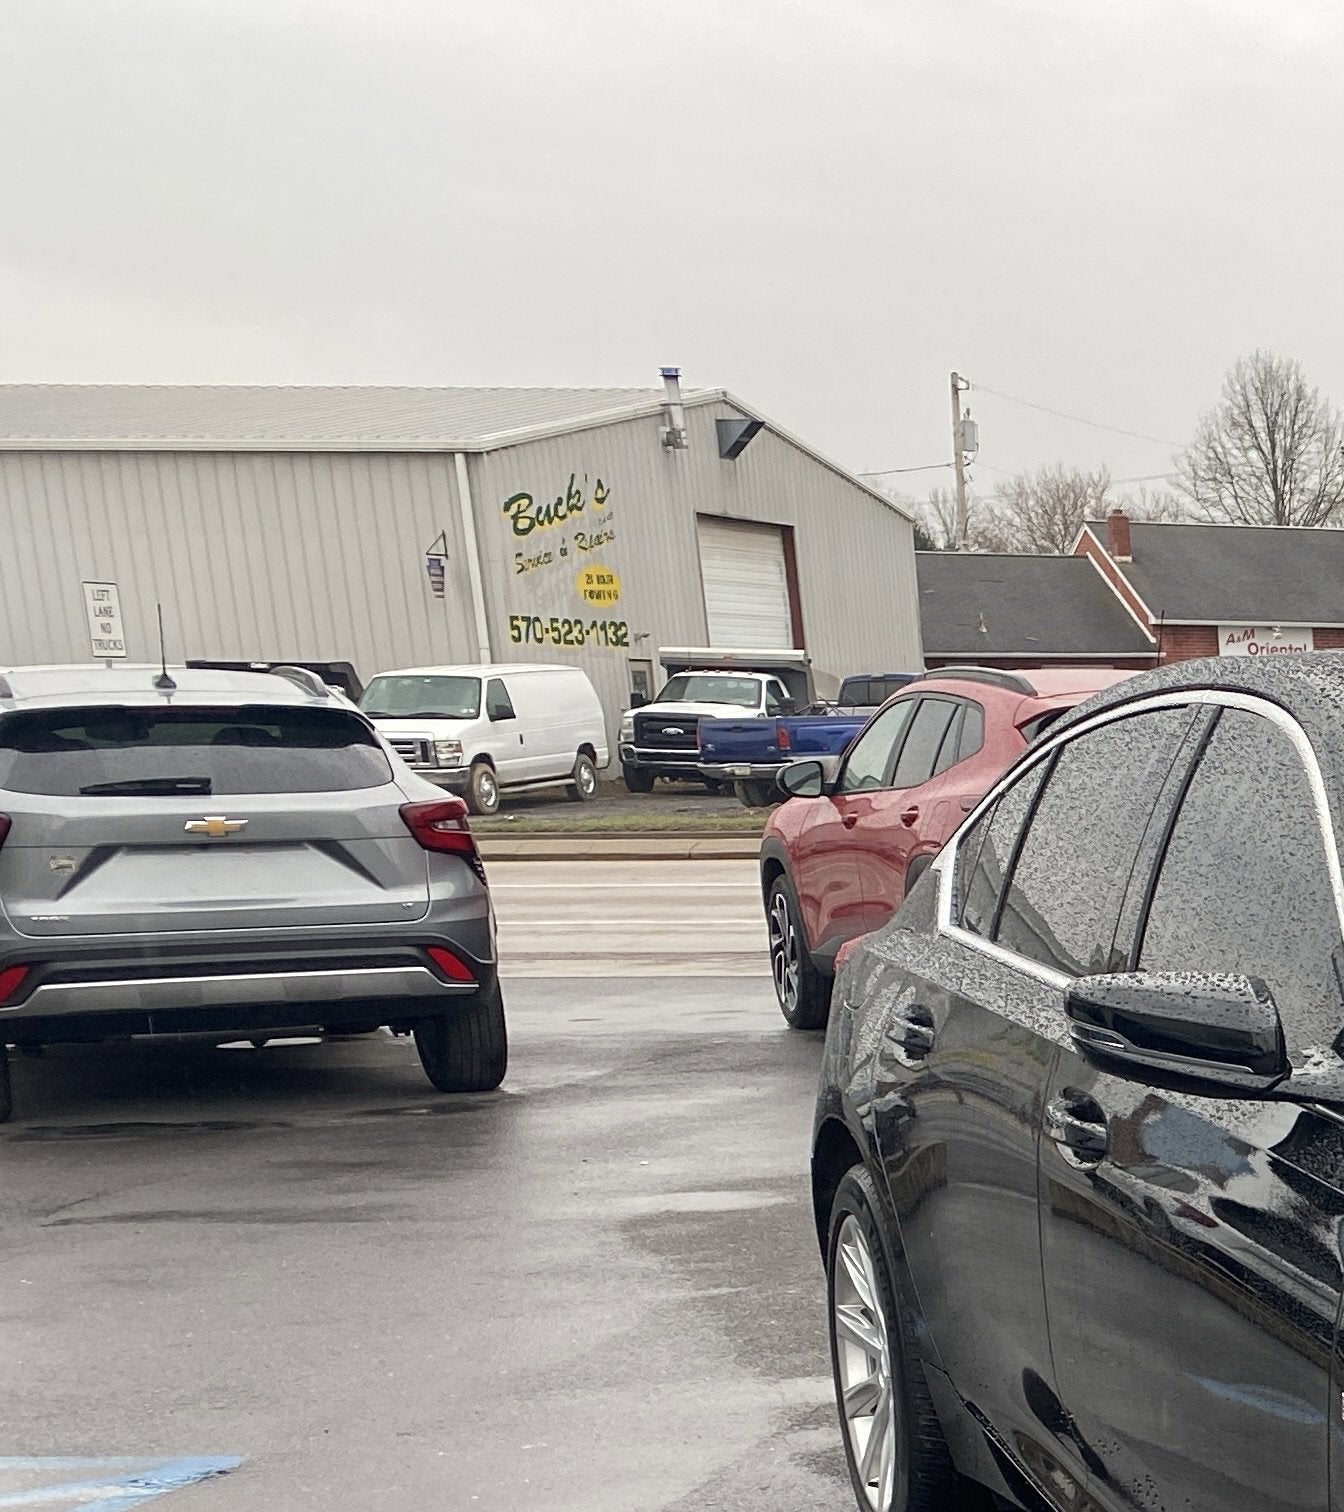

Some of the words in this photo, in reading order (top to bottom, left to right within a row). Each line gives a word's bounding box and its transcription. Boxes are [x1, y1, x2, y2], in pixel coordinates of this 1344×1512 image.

[503, 472, 611, 536] Buck's
[93, 606, 114, 617] LANE
[100, 623, 112, 634] NO
[1225, 628, 1256, 646] A&M
[92, 639, 124, 651] TRUCKS
